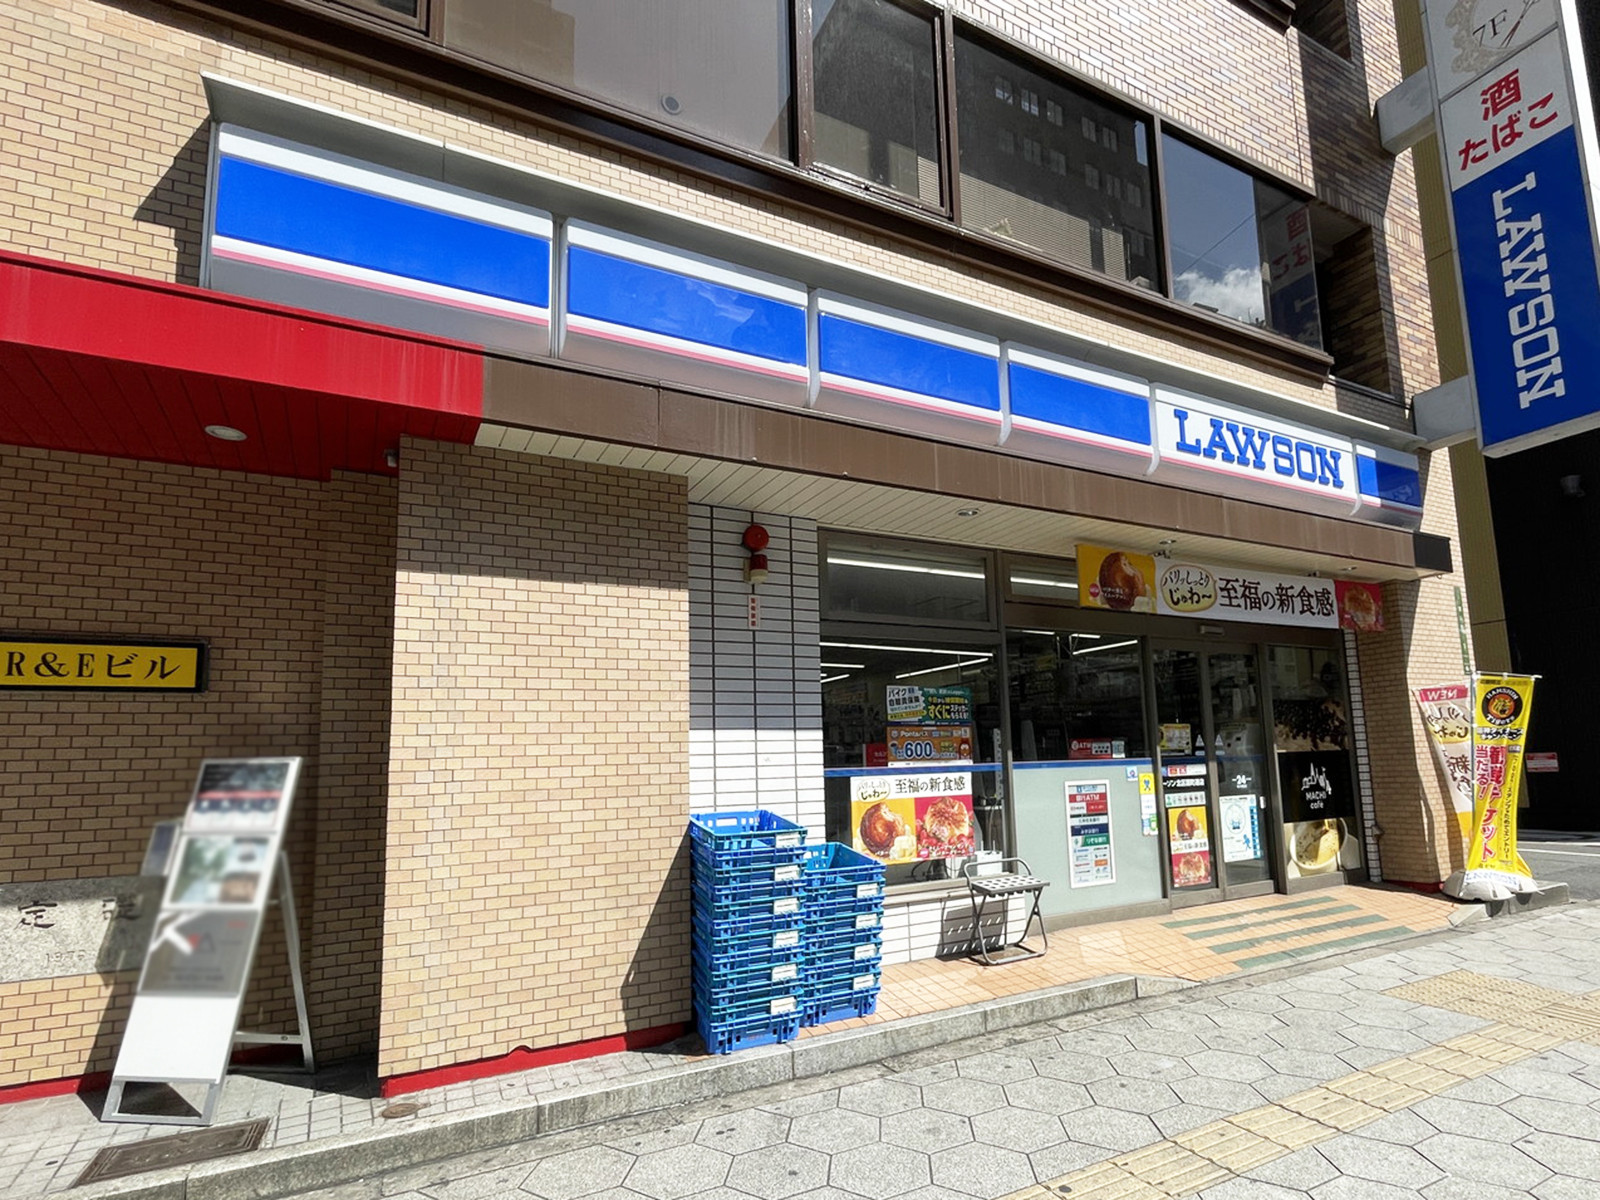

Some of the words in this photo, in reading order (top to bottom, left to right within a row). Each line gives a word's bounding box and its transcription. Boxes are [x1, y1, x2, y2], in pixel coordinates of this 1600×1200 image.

[1481, 68, 1522, 121] 酒
[1458, 92, 1558, 171] たばこ
[1492, 171, 1566, 410] LAWSON
[1173, 408, 1344, 489] LAWSON
[1218, 576, 1335, 617] 至福の新食感
[4, 650, 181, 681] R&Eビル
[888, 688, 907, 698] バイク
[928, 704, 951, 719] すぐに
[905, 741, 933, 758] 600
[895, 775, 966, 794] 至福の新食感
[1305, 791, 1327, 800] MACHI
